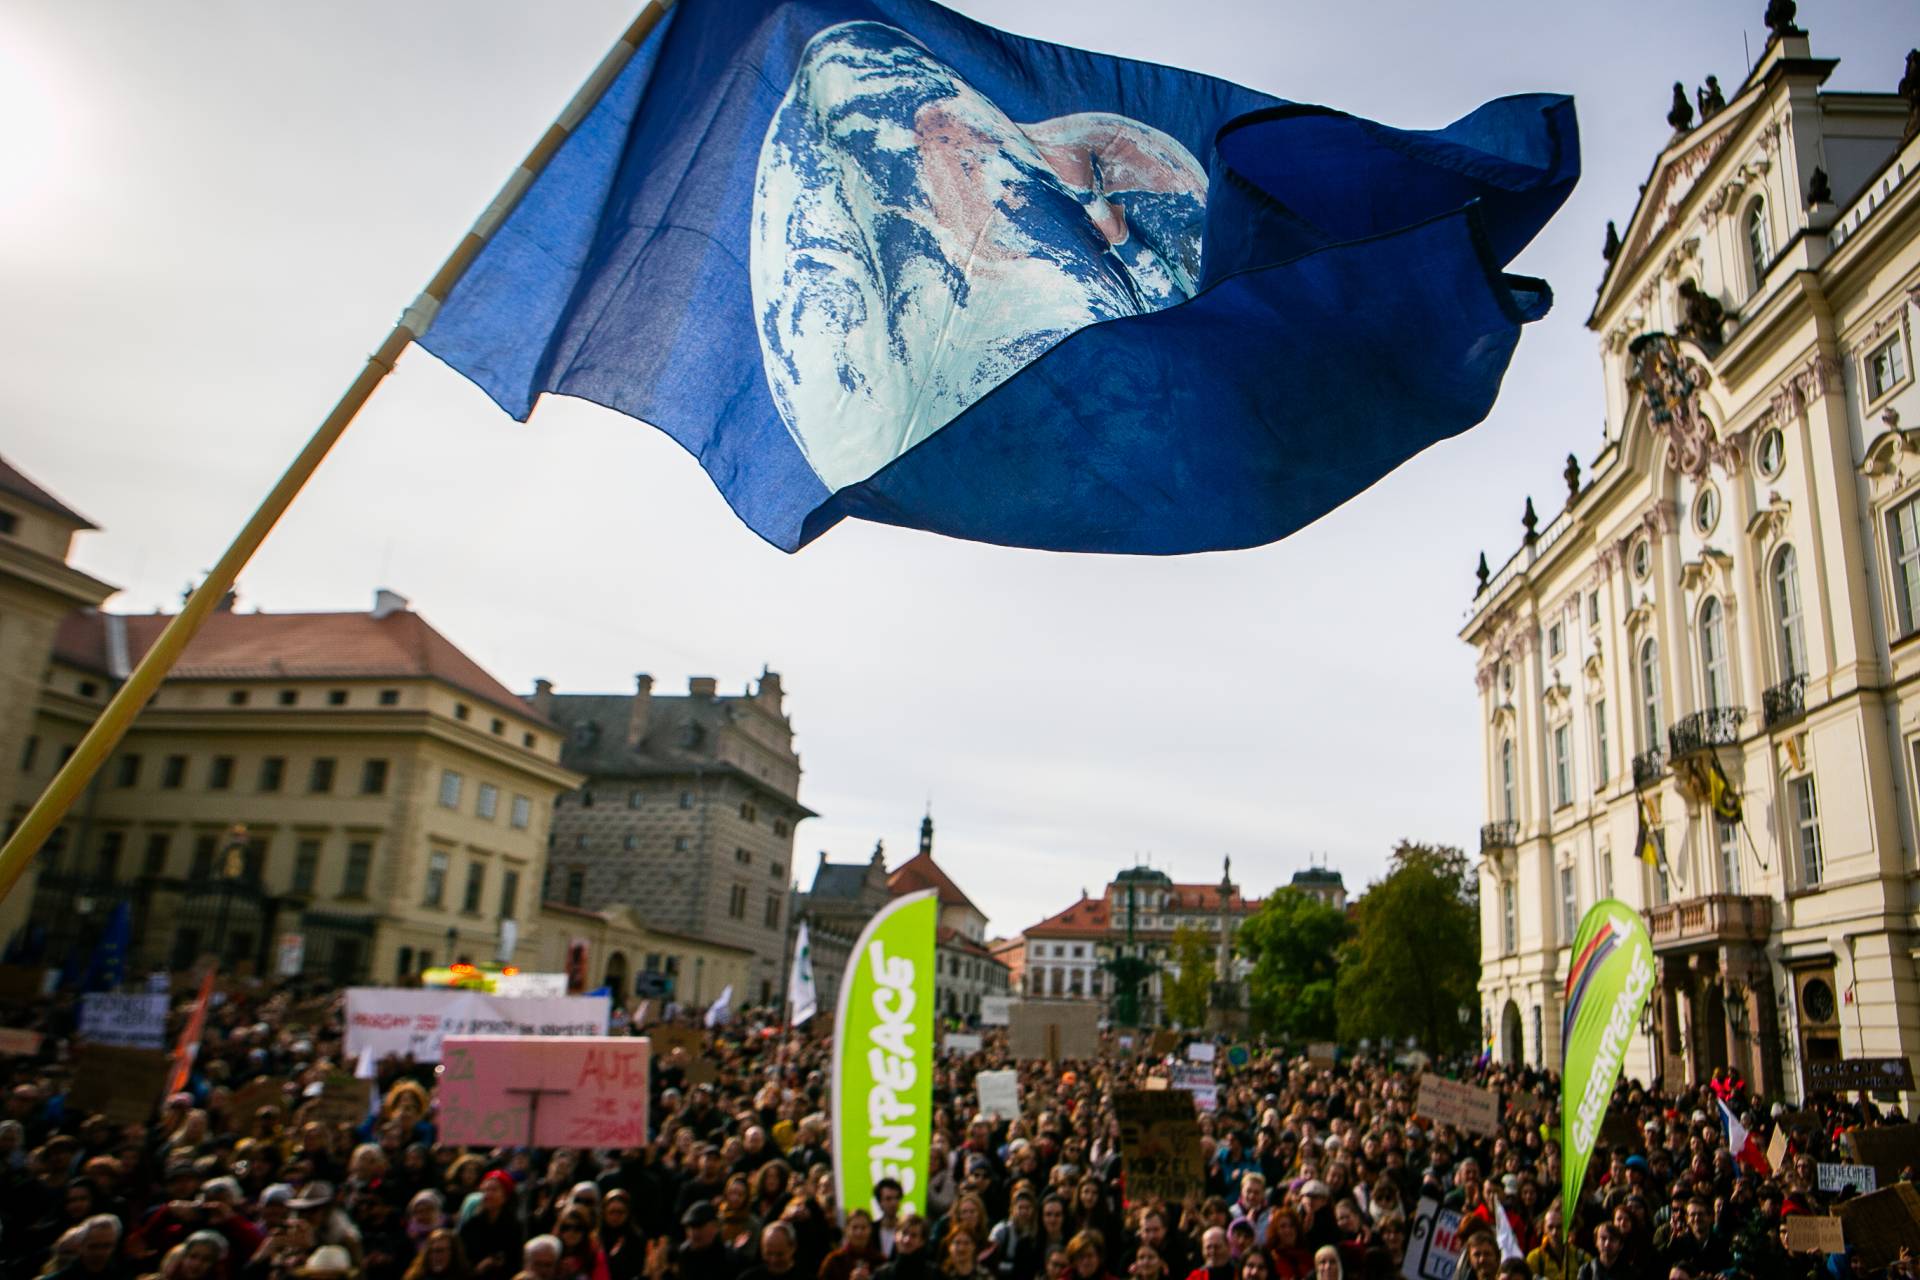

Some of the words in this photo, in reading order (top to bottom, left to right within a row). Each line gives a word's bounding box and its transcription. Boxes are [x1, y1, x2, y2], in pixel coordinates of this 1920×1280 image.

[577, 1049, 644, 1093] AUTO
[868, 940, 917, 1222] ENPEACE
[1572, 942, 1651, 1155] GREENPEACE
